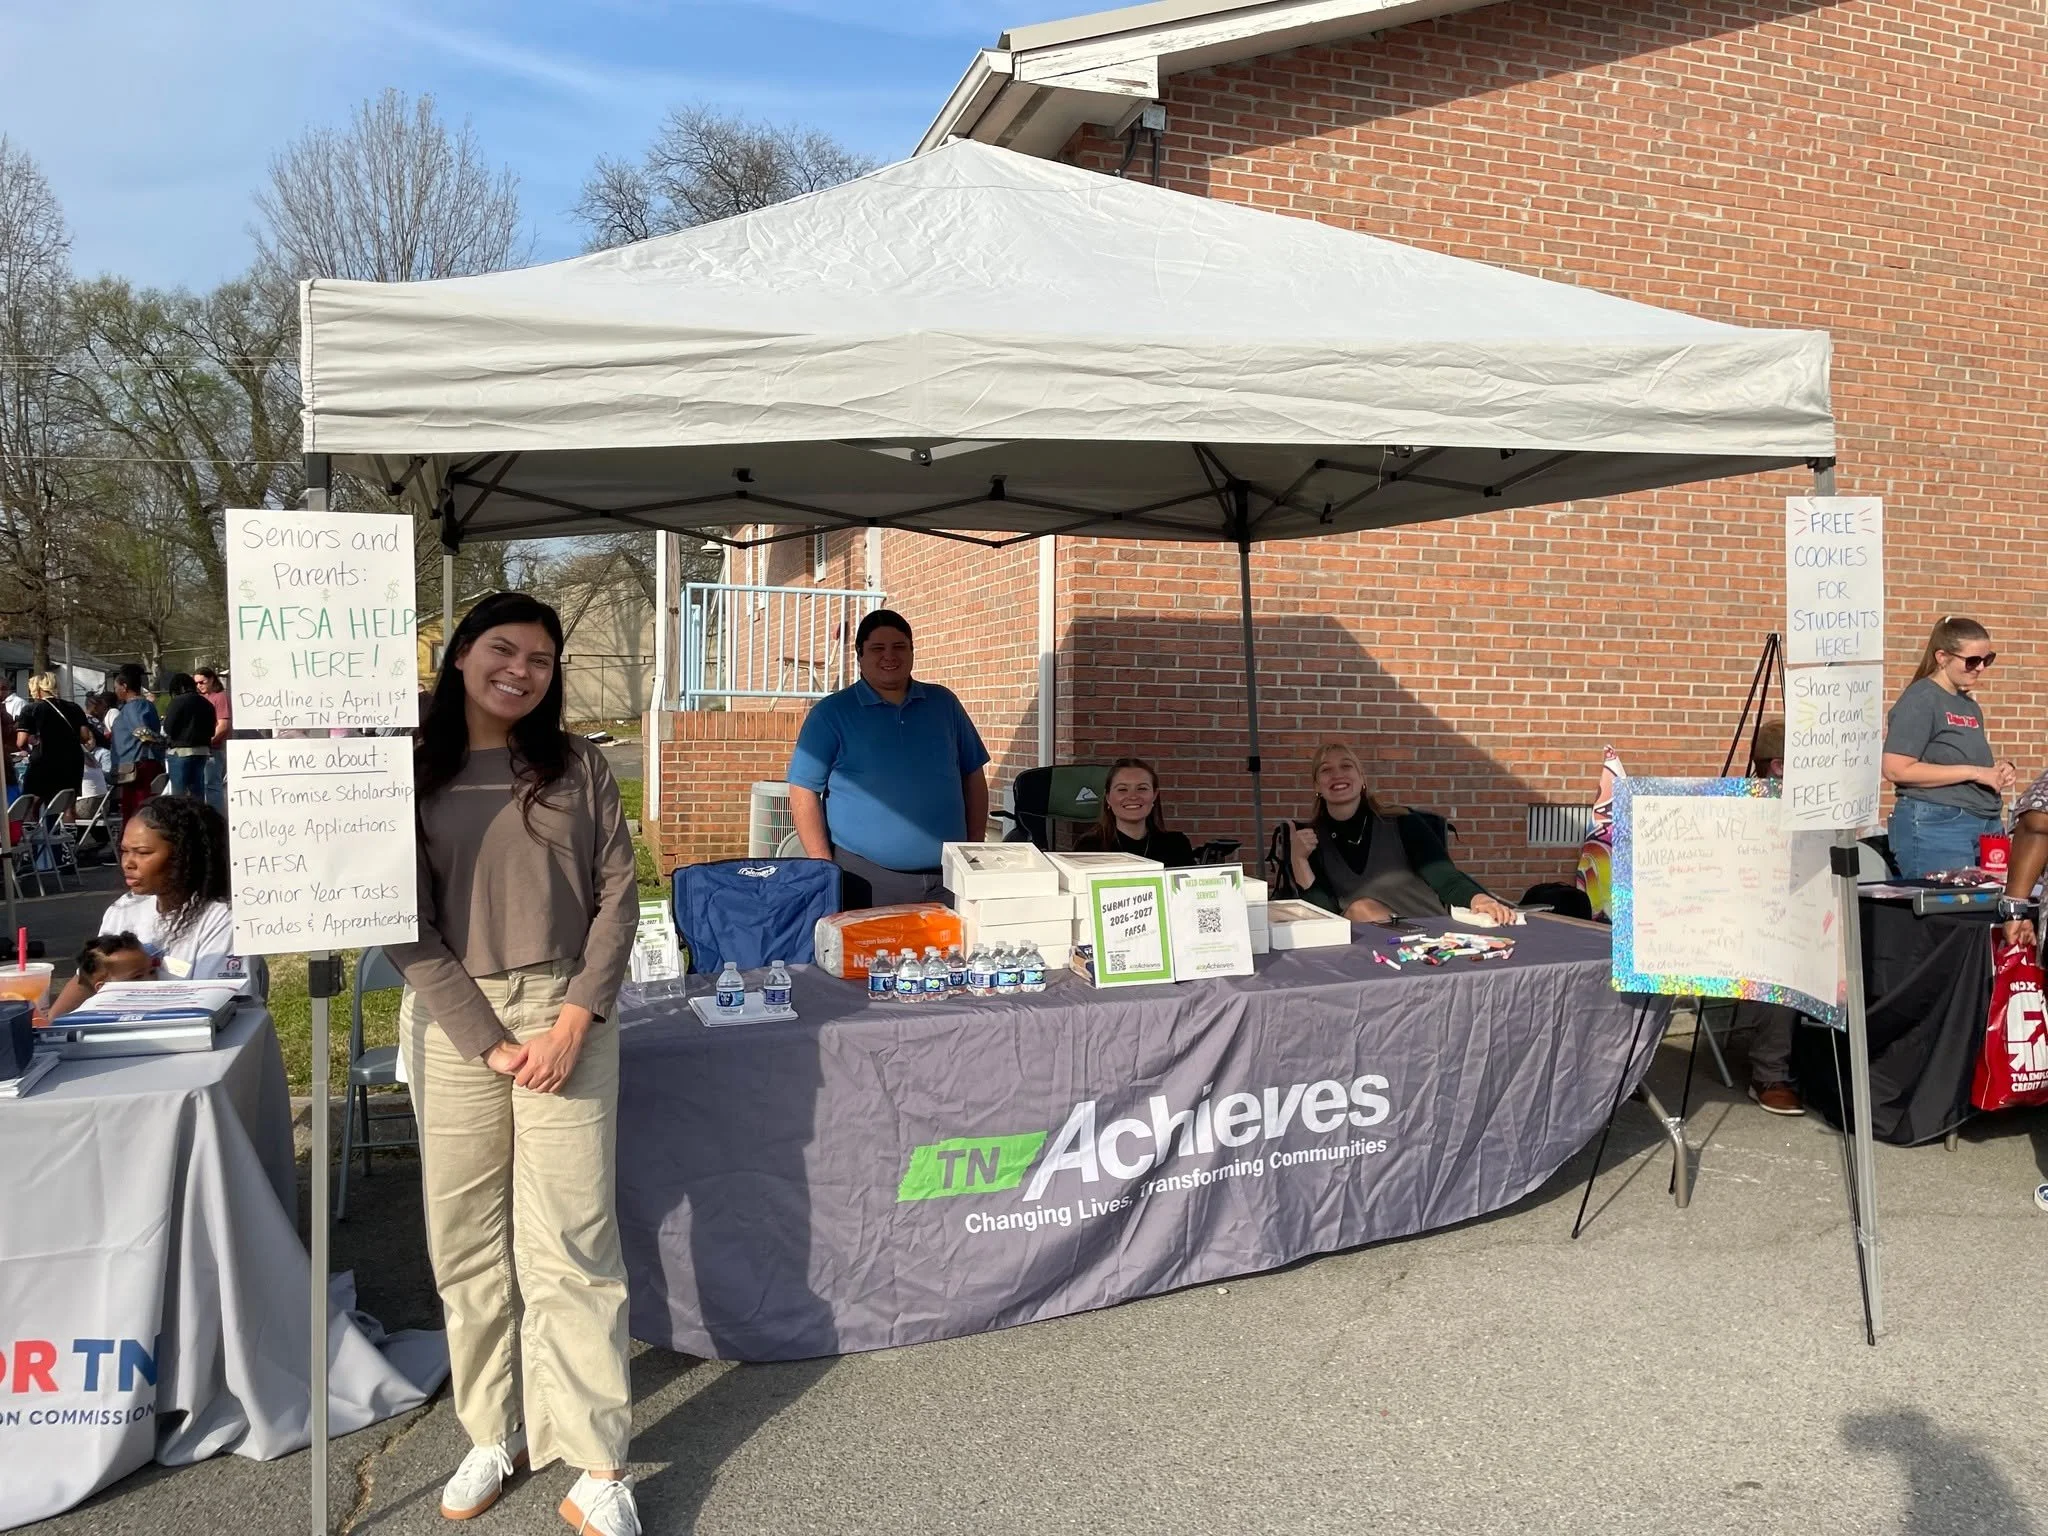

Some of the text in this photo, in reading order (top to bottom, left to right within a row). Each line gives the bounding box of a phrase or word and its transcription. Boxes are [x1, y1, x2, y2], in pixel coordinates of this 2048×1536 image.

[1811, 512, 1856, 534] FREE
[242, 519, 400, 552] Seniors and
[1794, 545, 1867, 568] COOKIES
[273, 561, 367, 589] Parents:
[1817, 580, 1851, 600] FOR
[238, 605, 417, 641] FAFSA HELP
[1793, 609, 1880, 632] STUDENTS
[1815, 632, 1860, 657] HERE!
[291, 644, 379, 679] HERE!
[1794, 675, 1872, 702] Share your
[239, 689, 407, 713] Deadline is April 1st
[269, 706, 399, 728] for TN Promise!
[1819, 701, 1864, 726] dream
[1841, 730, 1870, 751] major,
[1872, 730, 1880, 740] or
[243, 745, 388, 771] Ask me about:
[1792, 750, 1872, 770] career for a
[233, 781, 415, 807] TN Promise Scholarship
[1793, 781, 1840, 808] FREE
[1832, 783, 1879, 821] COOKIE!
[239, 817, 397, 846] College Applications
[244, 854, 308, 876] FAFSA
[242, 882, 399, 906] Senior Year Tasks
[1102, 891, 1154, 914] SUBMIT YOUR
[243, 916, 302, 938] Trades
[1110, 906, 1153, 927] 2026-2027
[1124, 923, 1147, 938] FAFSA
[2011, 1073, 2028, 1083] TVA
[2011, 1080, 2041, 1093] CREDIT
[937, 1073, 1391, 1202] TN Achieves
[965, 1205, 1072, 1234] Changing
[1140, 1157, 1264, 1197] Transforming
[1270, 1139, 1387, 1170] Communities
[0, 1335, 161, 1394] R TN
[0, 1403, 156, 1426] N COMMISSION
